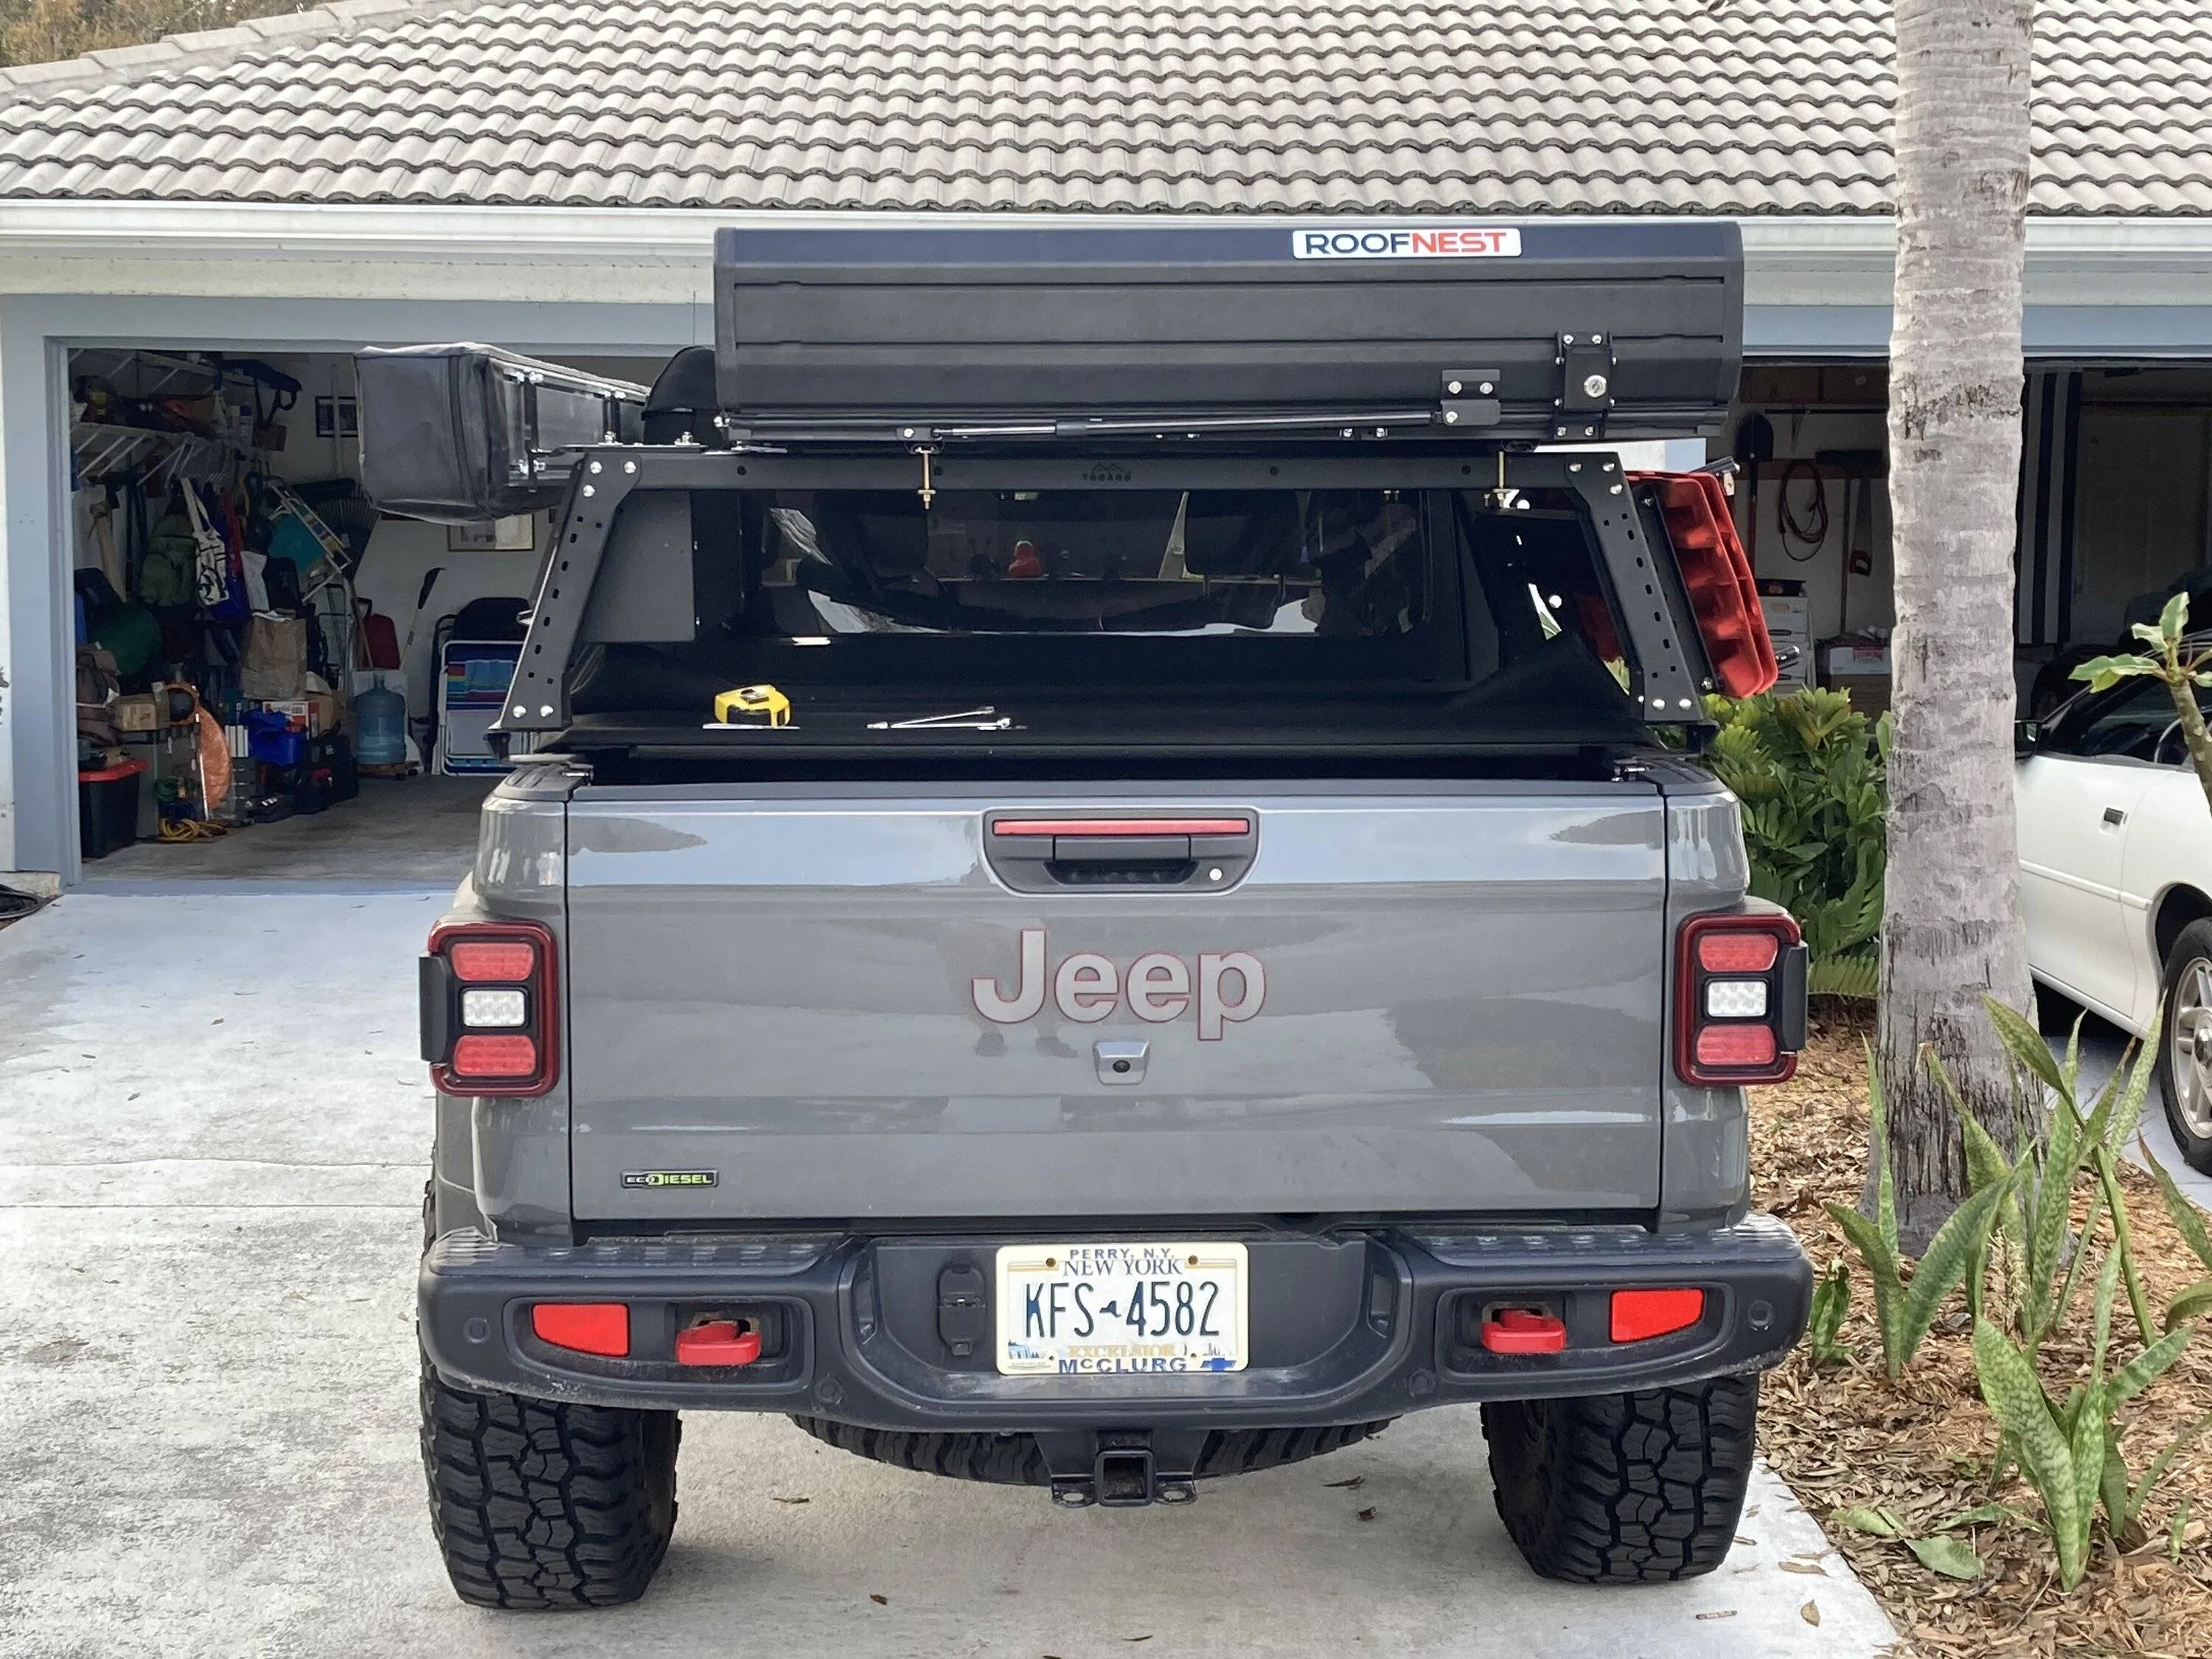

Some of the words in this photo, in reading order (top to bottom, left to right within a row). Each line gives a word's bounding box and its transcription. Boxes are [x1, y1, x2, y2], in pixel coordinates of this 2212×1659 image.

[1304, 232, 1507, 254] ROOFNEST
[970, 926, 1267, 1041] Jeep
[1069, 1248, 1134, 1261] PERRY,
[1144, 1248, 1175, 1259] N.Y.
[1062, 1259, 1115, 1277] NEW
[1124, 1259, 1183, 1276] YORK
[1025, 1282, 1095, 1338] KFS
[1125, 1281, 1220, 1338] 4582
